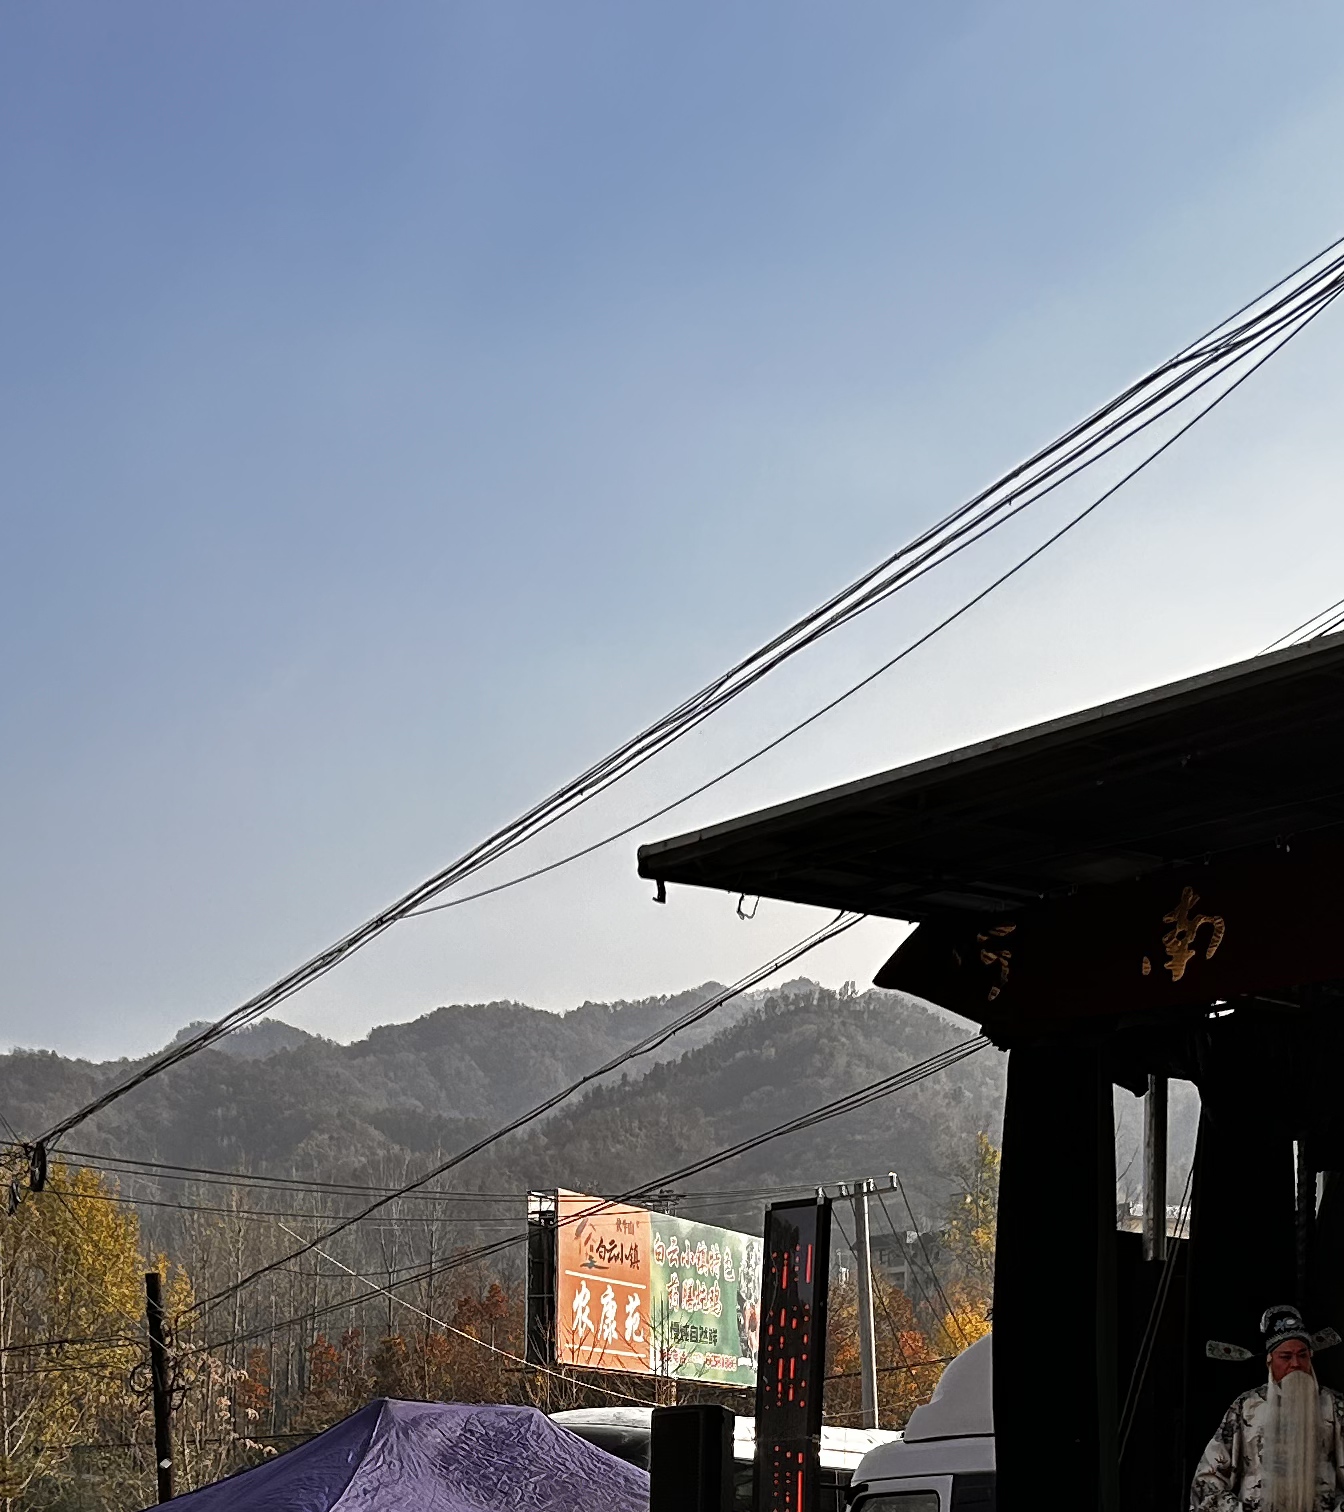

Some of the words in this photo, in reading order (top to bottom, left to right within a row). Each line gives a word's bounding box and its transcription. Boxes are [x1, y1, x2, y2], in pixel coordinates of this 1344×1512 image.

[596, 1235, 640, 1270] 白云小镇
[654, 1232, 735, 1282] 白云小镇特色
